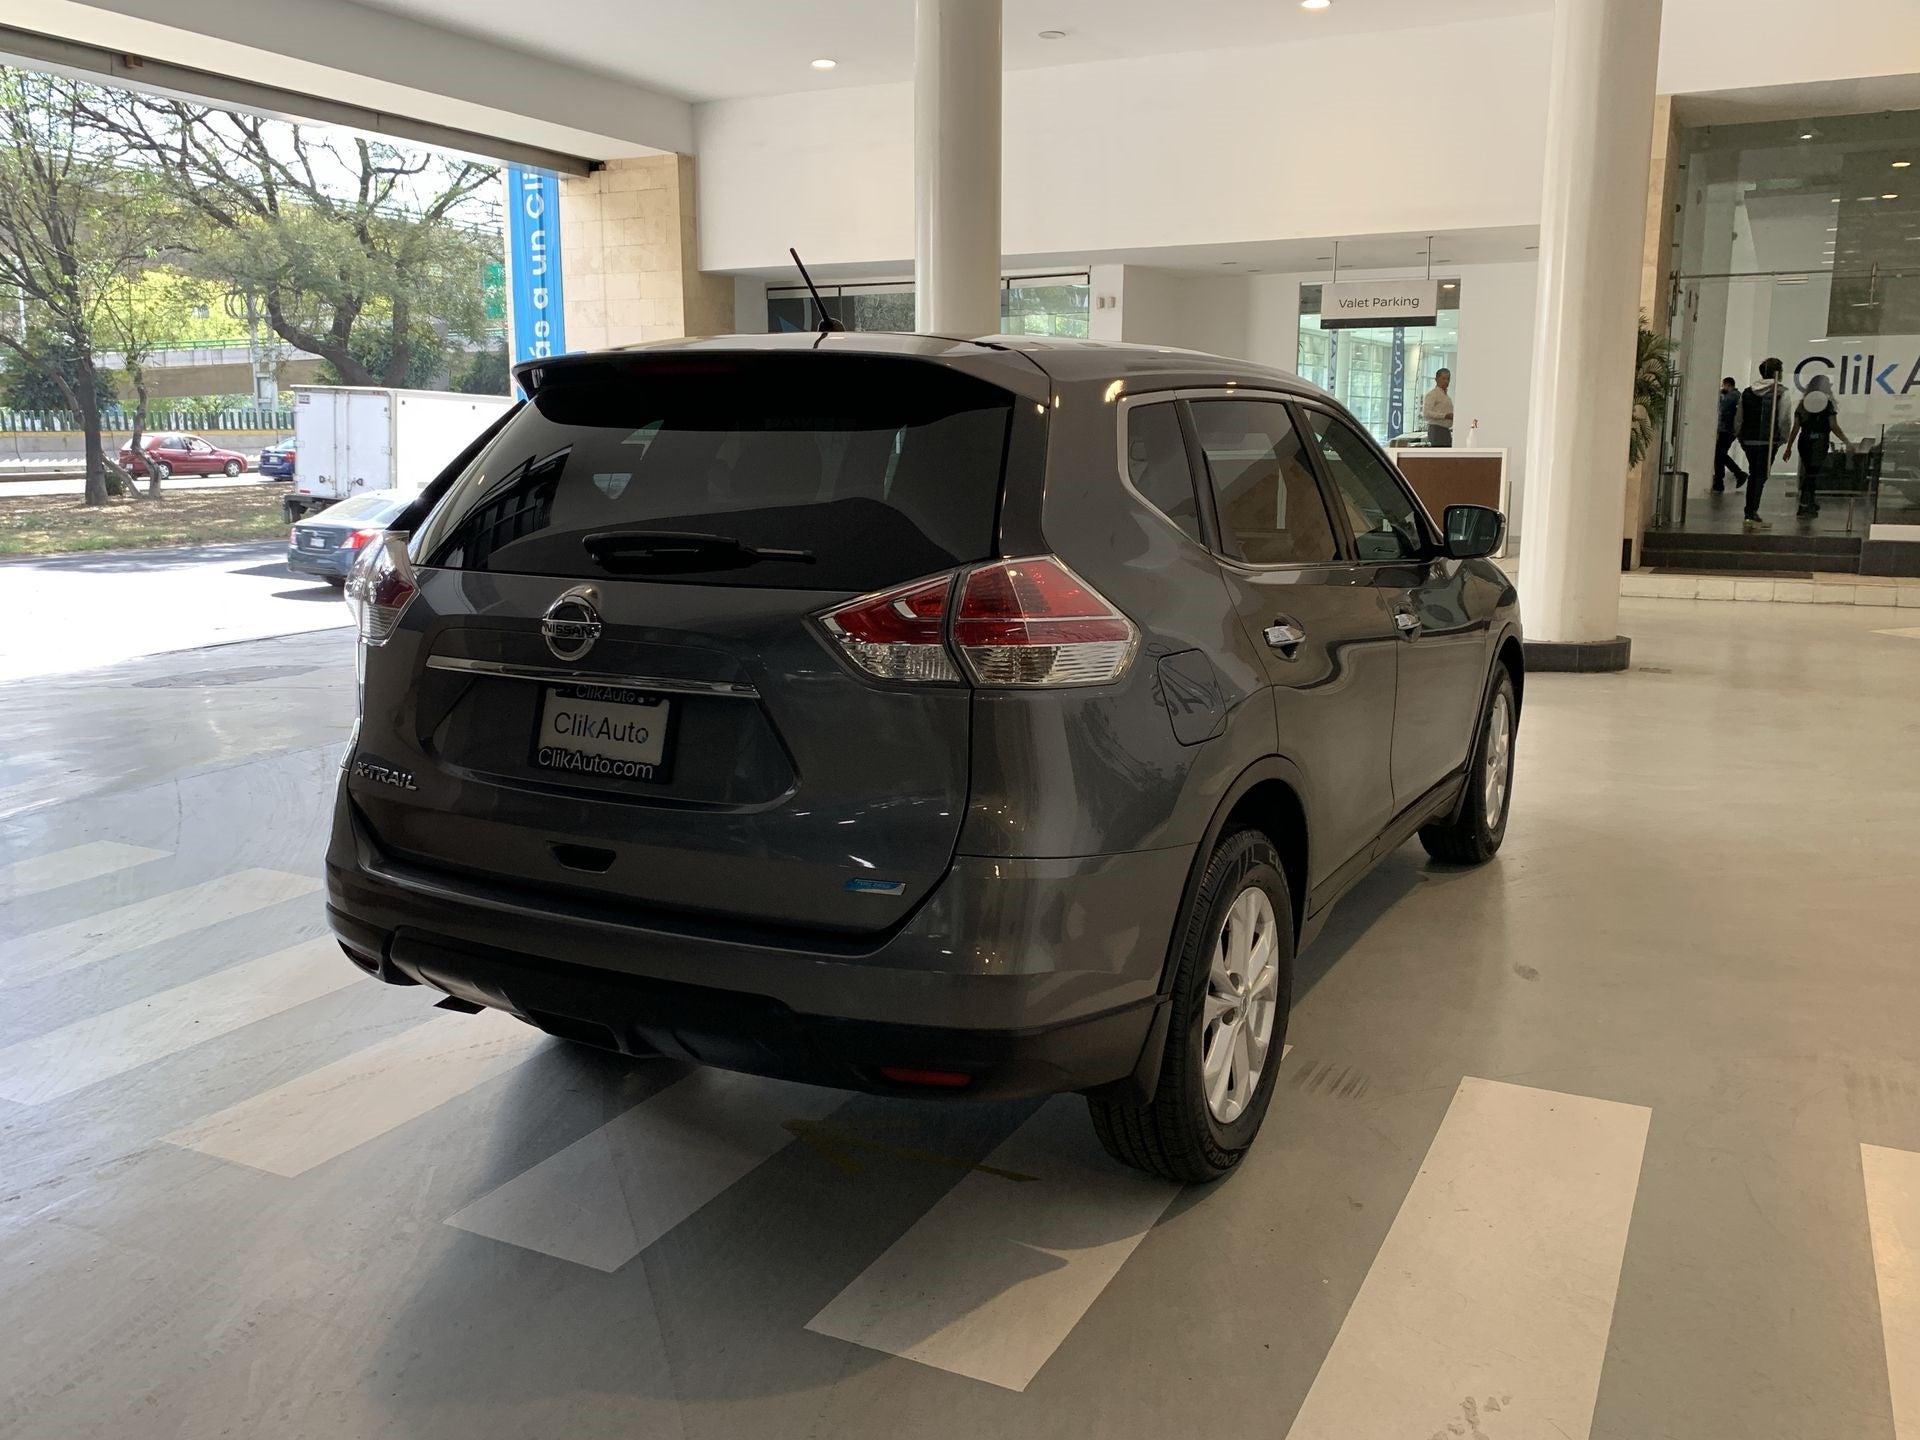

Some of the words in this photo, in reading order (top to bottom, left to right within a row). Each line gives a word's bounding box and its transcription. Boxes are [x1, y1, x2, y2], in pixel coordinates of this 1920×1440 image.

[523, 172, 545, 220] Cli
[531, 230, 547, 276] un
[533, 287, 548, 310] a
[1338, 298, 1369, 309] Valet
[1372, 296, 1420, 309] Parking
[528, 320, 551, 358] ás
[544, 624, 593, 637] NISSAN
[553, 711, 649, 744] ClikAuto
[355, 761, 417, 791] X-TRAIL
[537, 745, 654, 780] ClikAuto.com
